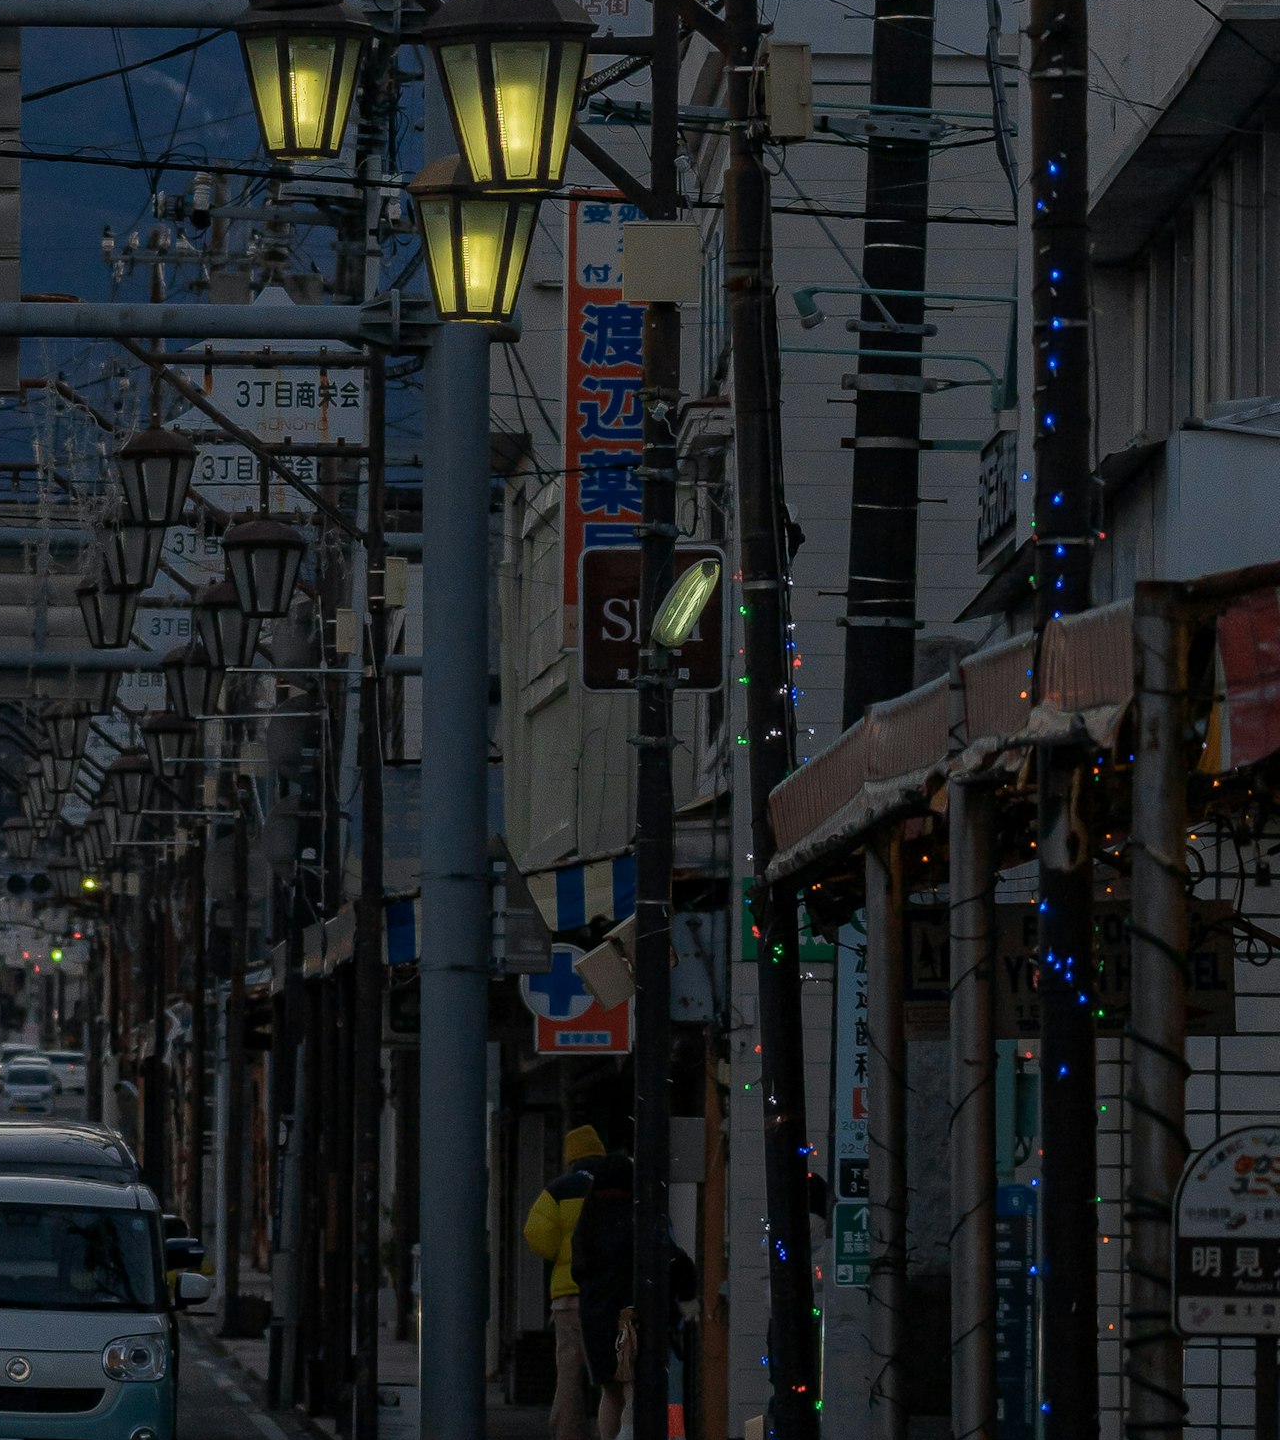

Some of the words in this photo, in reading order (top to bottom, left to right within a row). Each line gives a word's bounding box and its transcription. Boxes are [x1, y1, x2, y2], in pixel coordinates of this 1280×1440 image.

[235, 380, 361, 409] 3丁目商栄会
